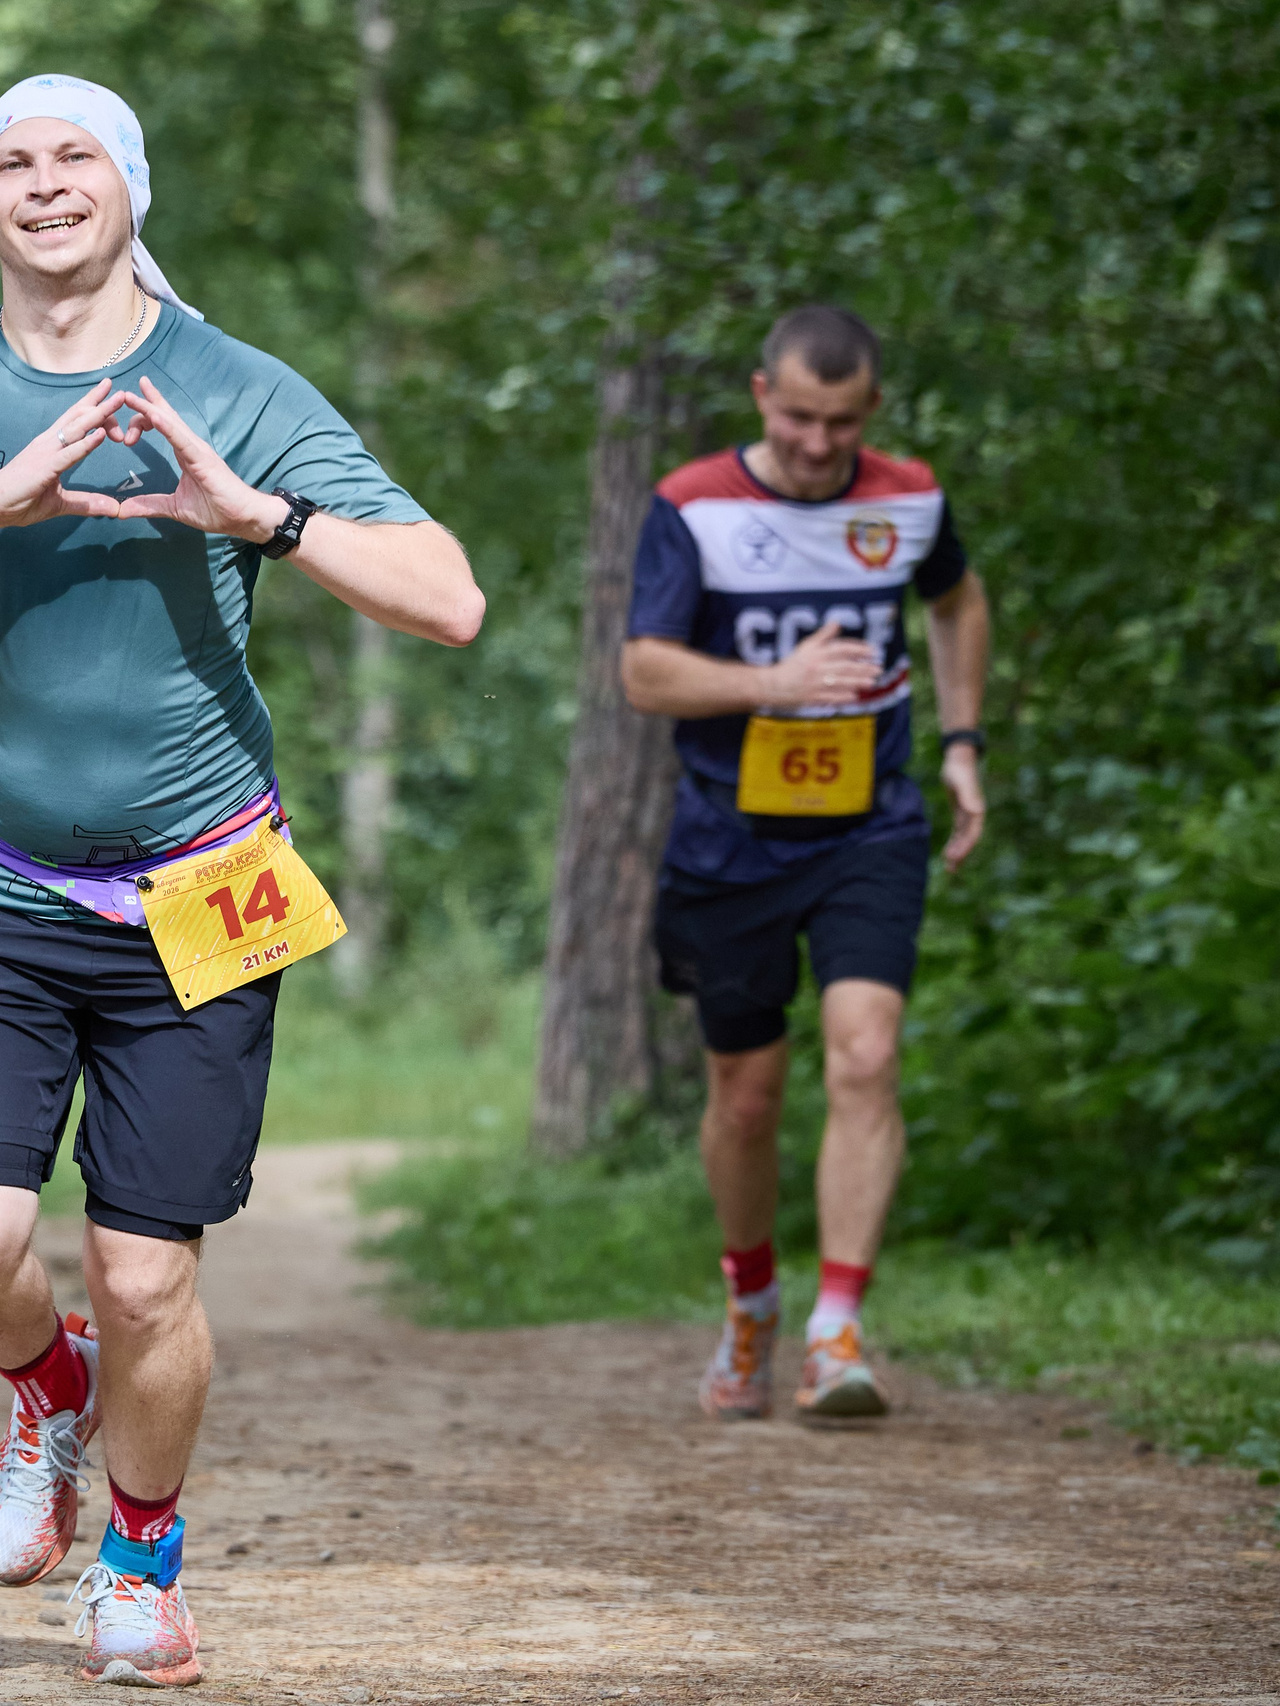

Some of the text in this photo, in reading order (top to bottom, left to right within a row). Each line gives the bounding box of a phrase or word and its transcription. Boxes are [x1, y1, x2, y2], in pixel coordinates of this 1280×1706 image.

[780, 746, 840, 785] 65
[195, 859, 233, 881] РЕТРО
[157, 875, 186, 888] августа
[163, 886, 180, 897] 2026
[205, 868, 290, 941] 14
[242, 953, 261, 970] 21
